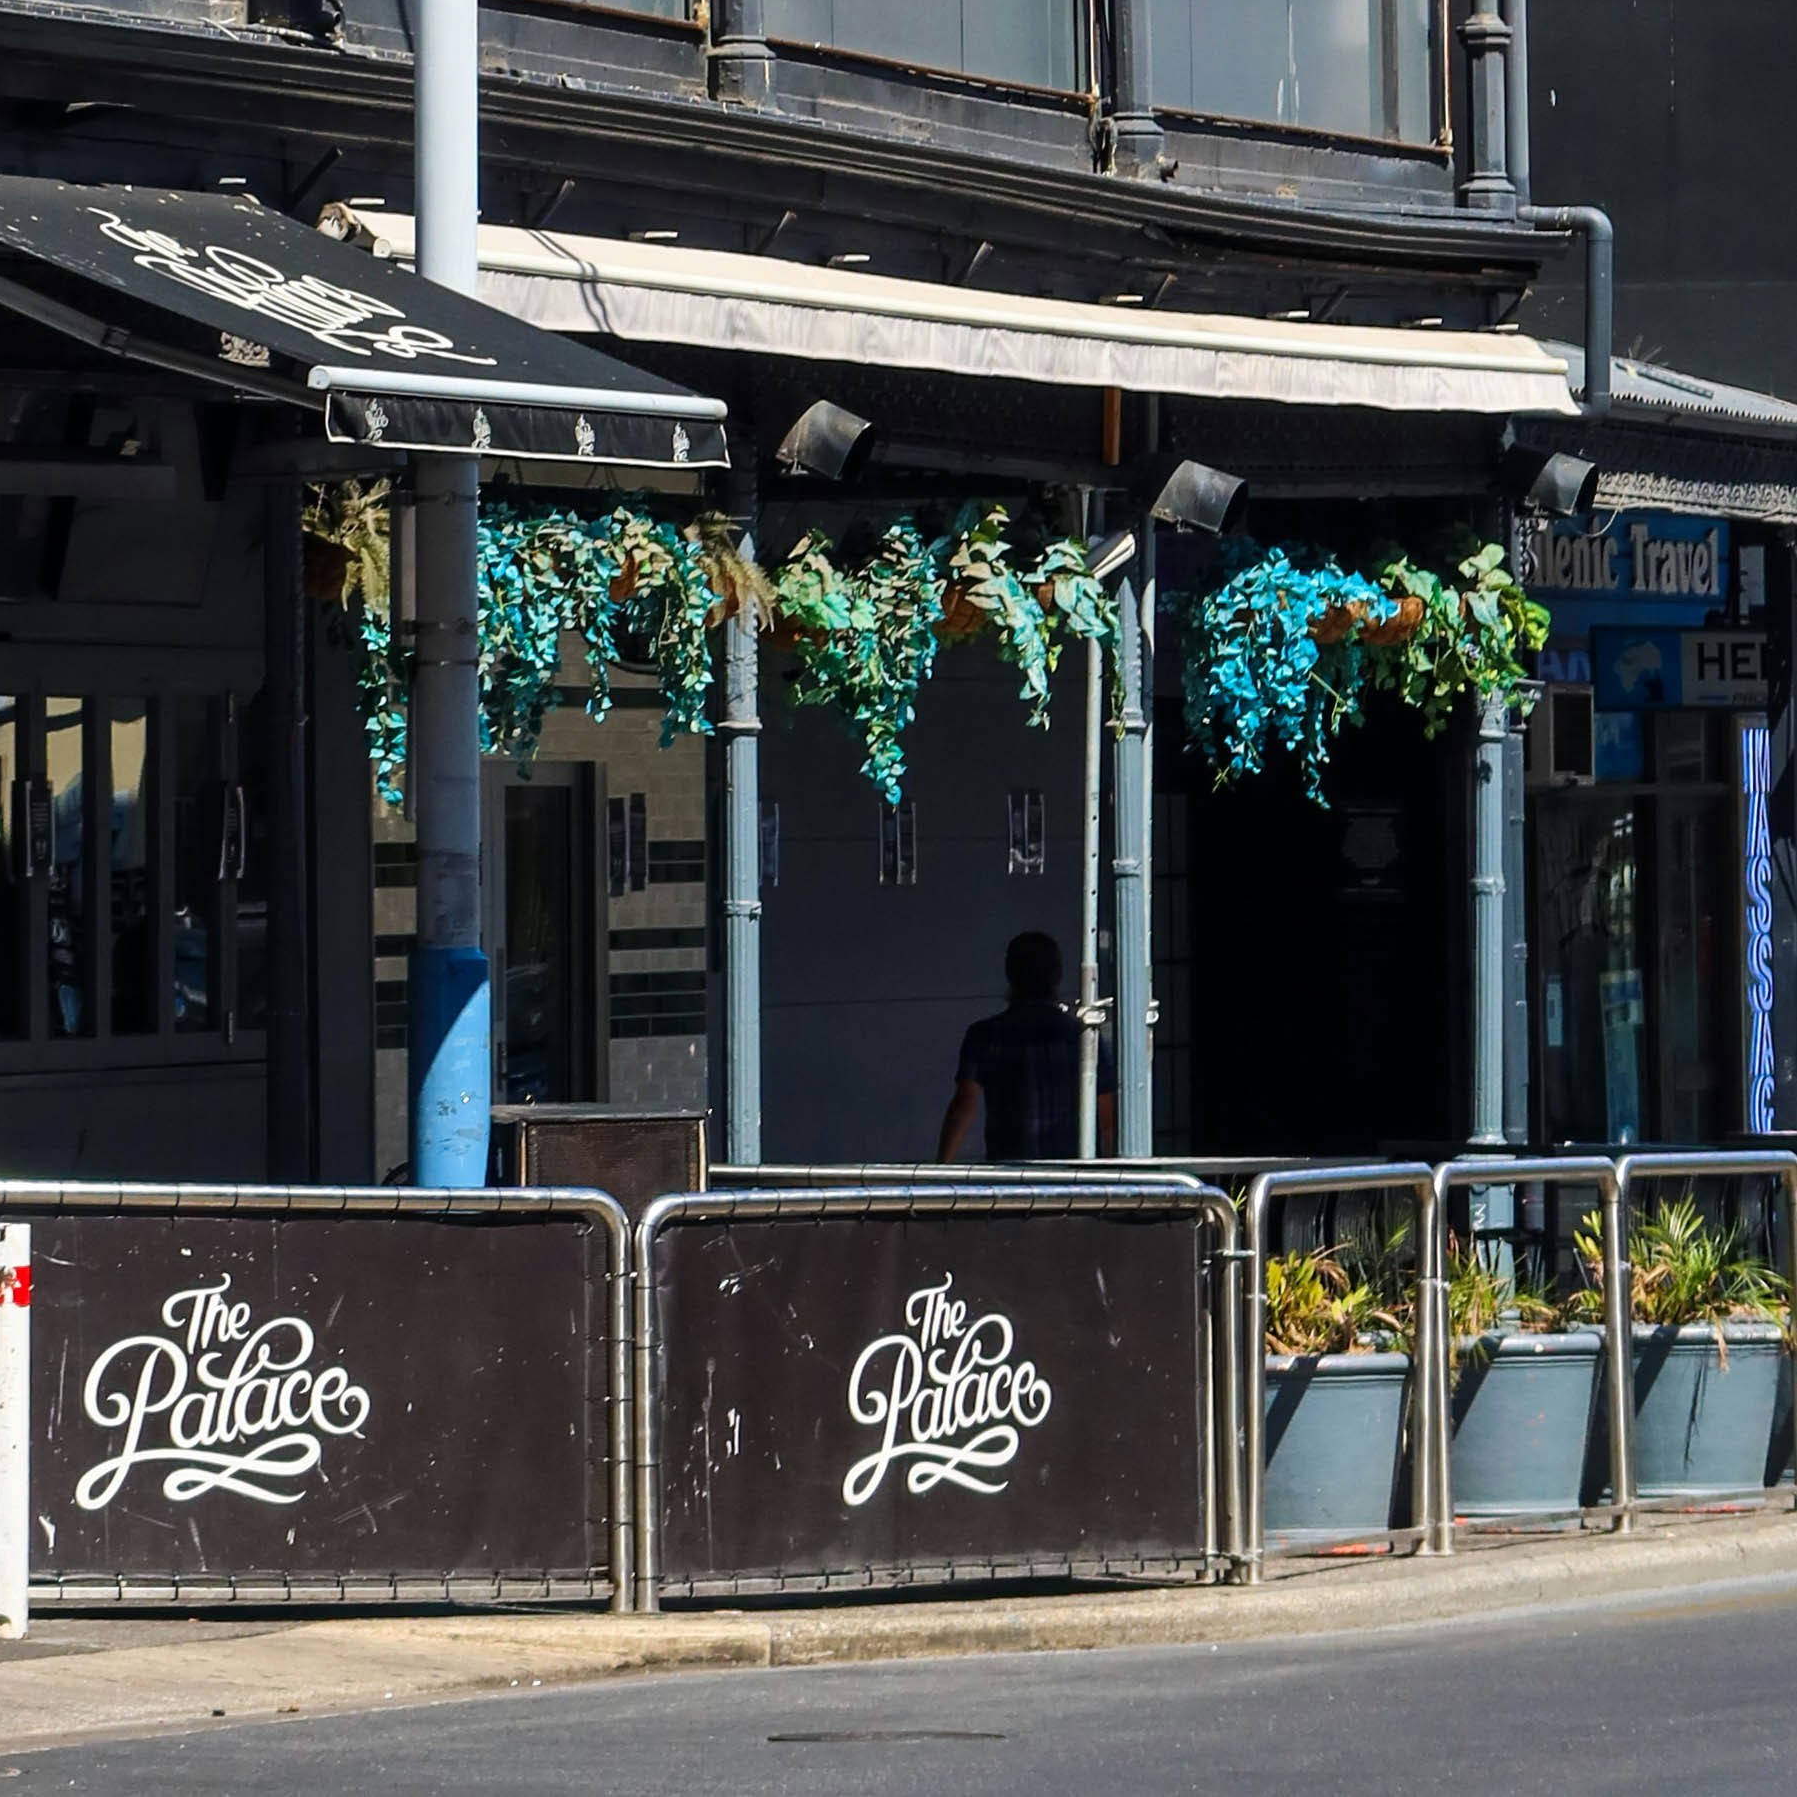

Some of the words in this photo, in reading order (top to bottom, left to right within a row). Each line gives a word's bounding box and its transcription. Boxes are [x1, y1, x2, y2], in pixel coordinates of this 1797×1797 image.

[1530, 518, 1619, 591] llenic
[1630, 523, 1720, 597] Travel
[161, 1273, 250, 1355] The
[906, 1271, 967, 1353] The
[75, 1316, 371, 1511] Palace
[843, 1313, 1052, 1506] Palace
